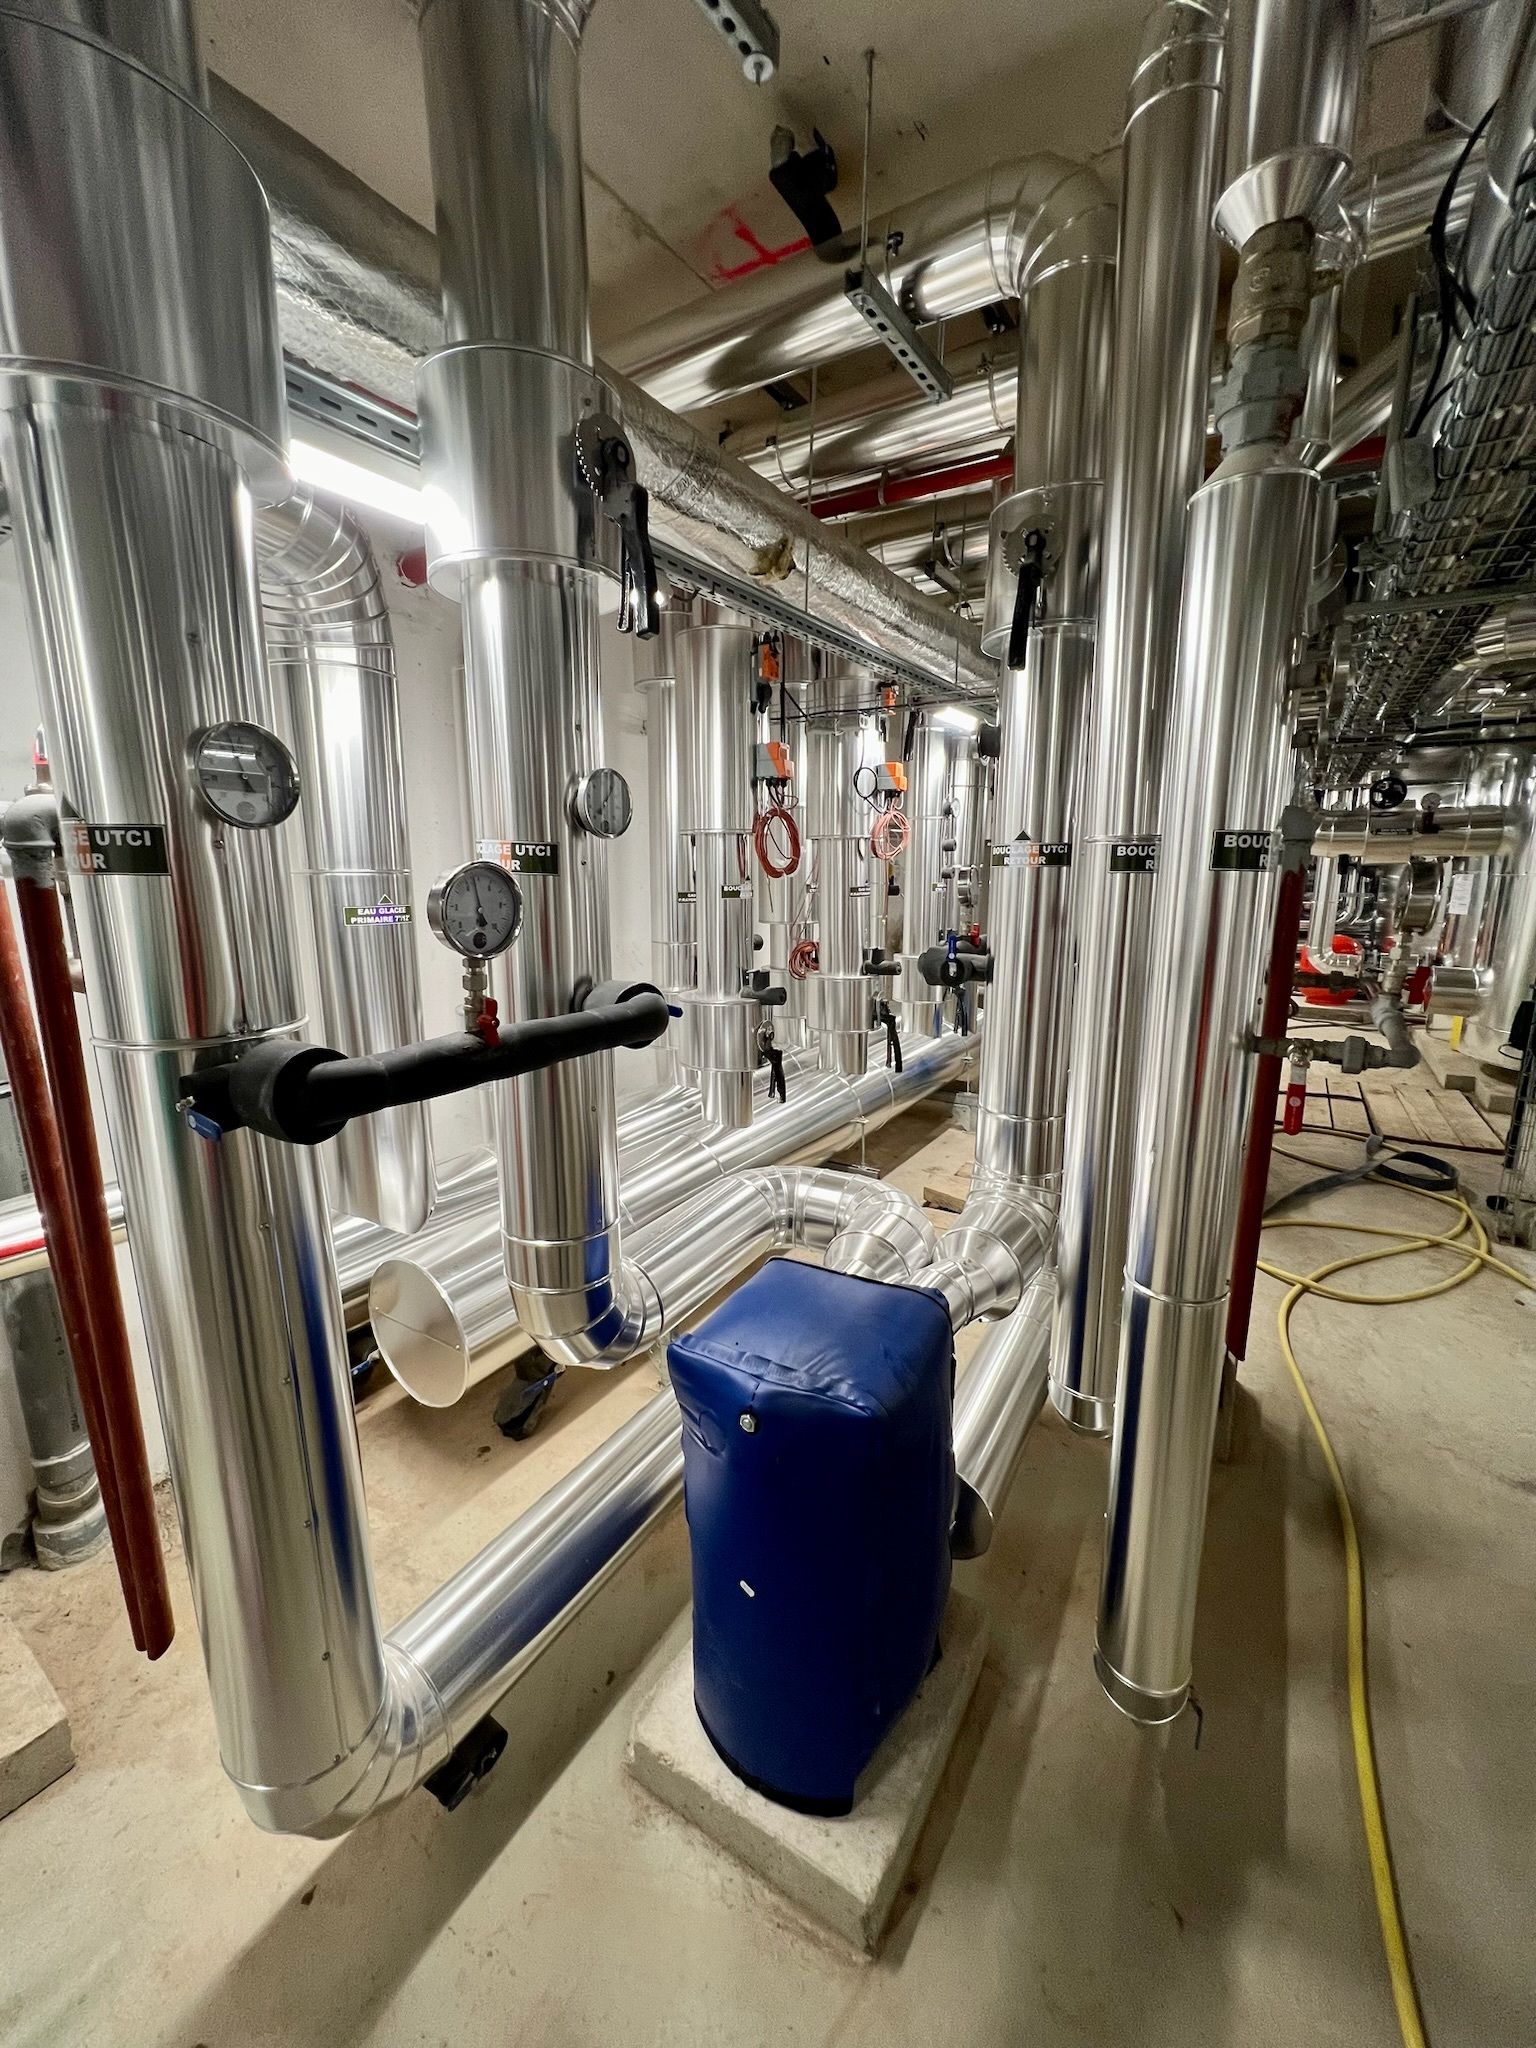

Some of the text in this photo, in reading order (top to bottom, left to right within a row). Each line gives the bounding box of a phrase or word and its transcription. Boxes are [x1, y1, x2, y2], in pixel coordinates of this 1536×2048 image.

[94, 829, 151, 847] UTCI
[515, 844, 550, 857] UTCI
[1042, 845, 1068, 854] UTCI
[357, 908, 377, 916] EAU
[350, 915, 394, 924] PRIMAIRE
